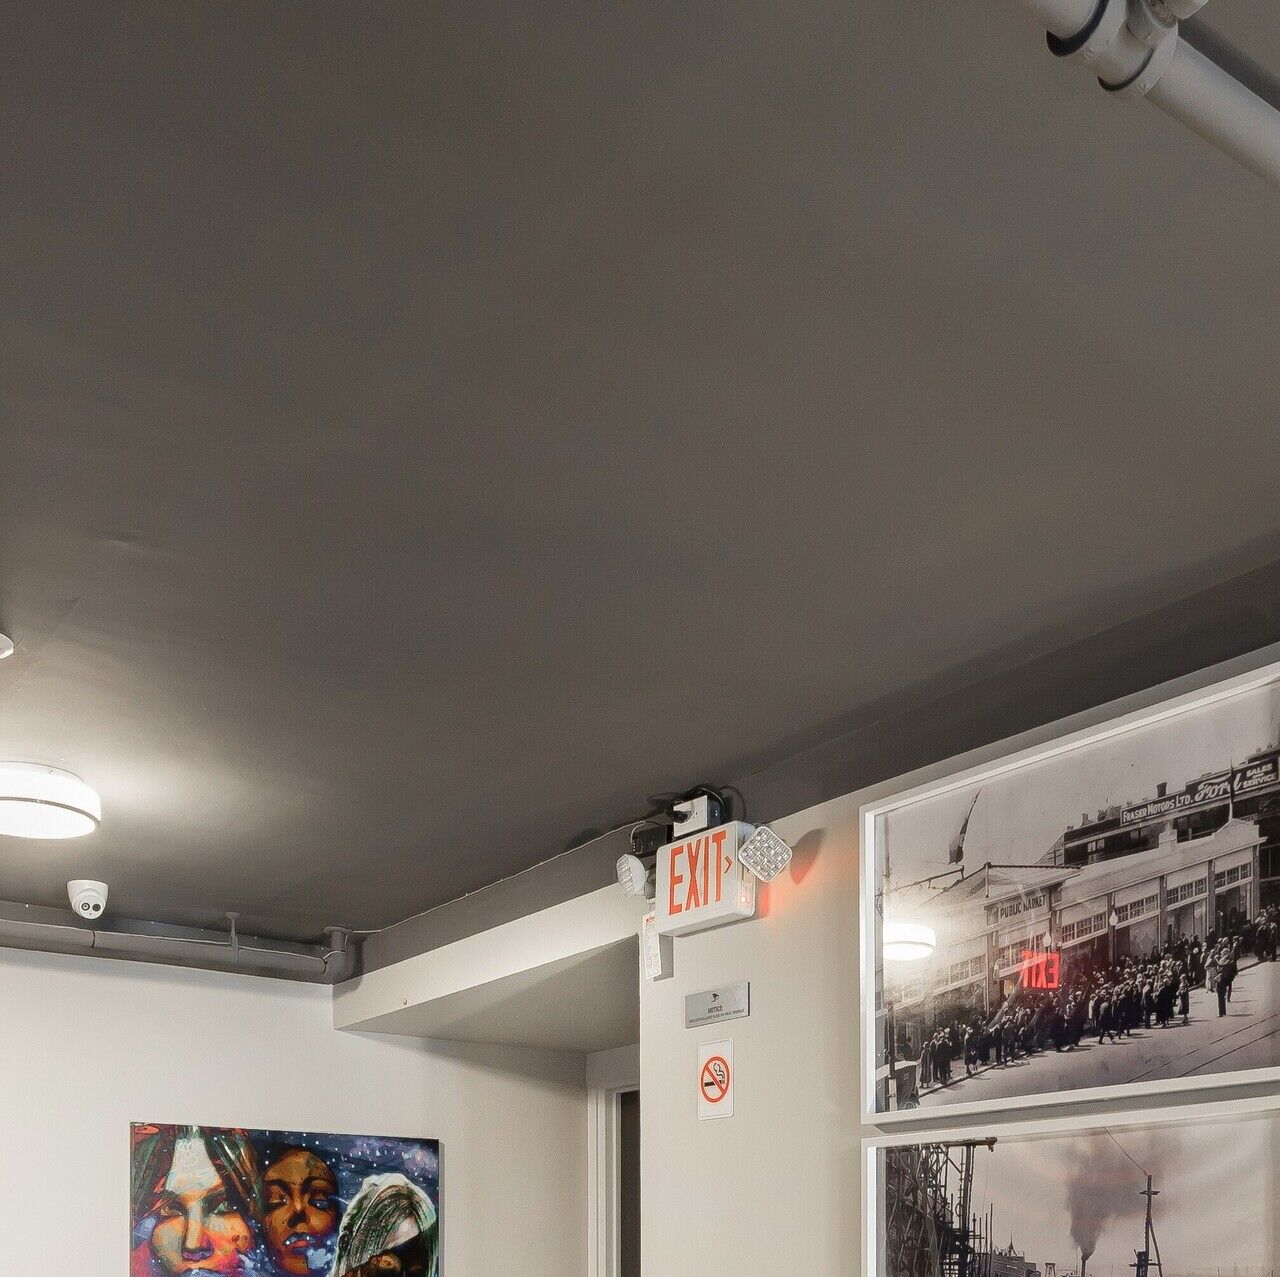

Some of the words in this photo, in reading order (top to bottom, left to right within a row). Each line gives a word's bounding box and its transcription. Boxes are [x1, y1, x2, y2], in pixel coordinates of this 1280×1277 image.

[1123, 807, 1147, 822] FRASER
[668, 829, 727, 916] EXIT
[1000, 901, 1022, 919] PUBLIC
